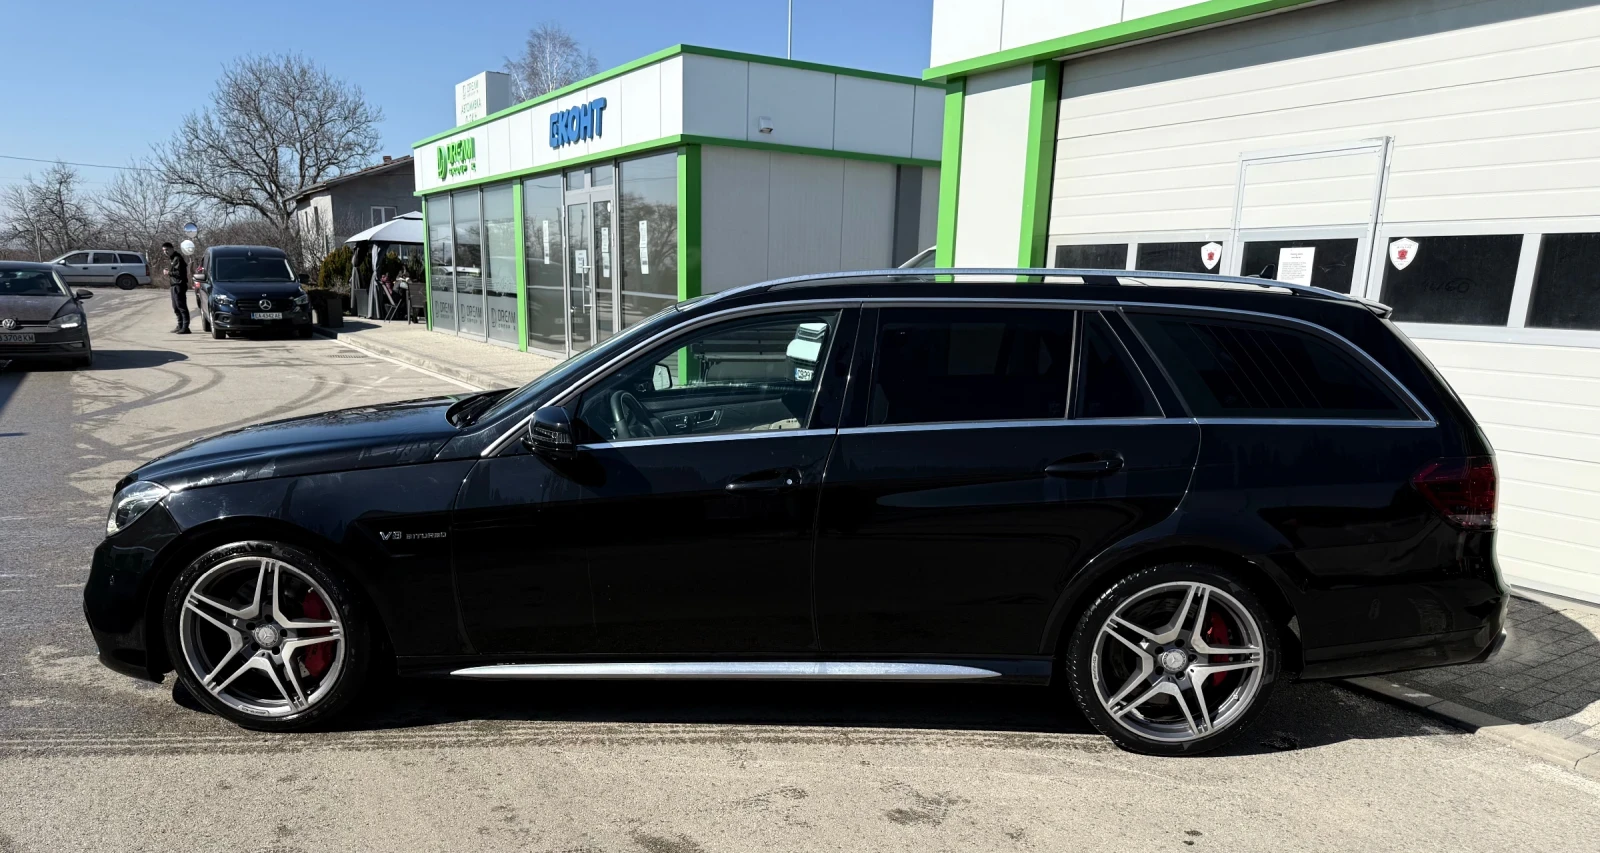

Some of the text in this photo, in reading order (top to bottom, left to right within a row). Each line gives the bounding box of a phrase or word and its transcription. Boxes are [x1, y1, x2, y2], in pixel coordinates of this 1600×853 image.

[447, 137, 476, 164] DREAM
[498, 309, 516, 323] DREAM
[379, 531, 447, 541] V8 BITURBO
